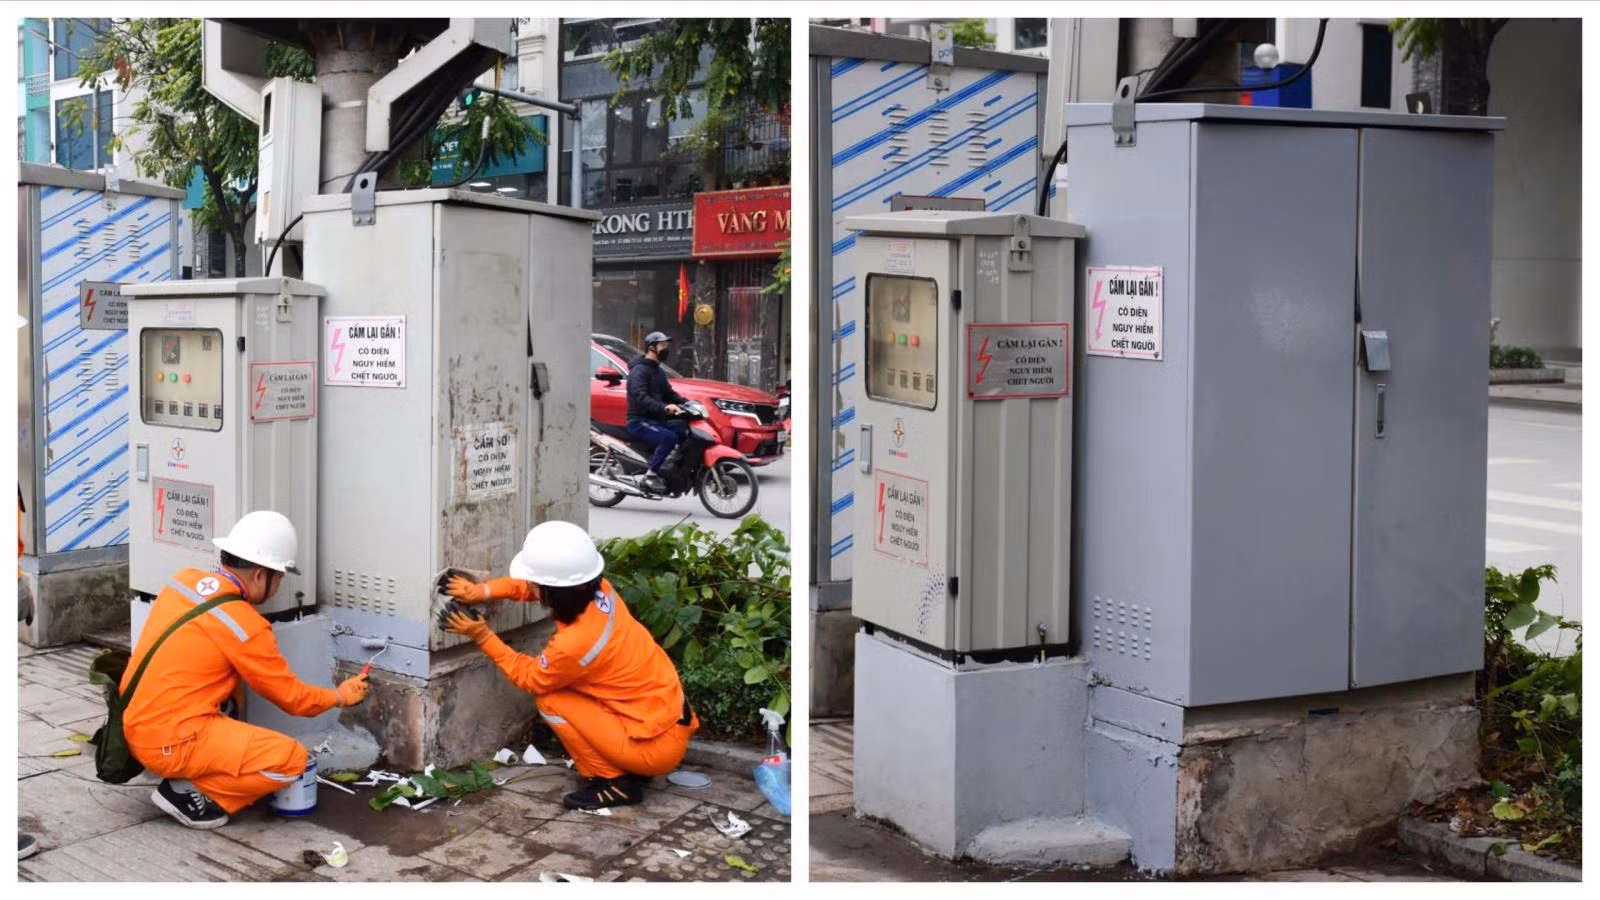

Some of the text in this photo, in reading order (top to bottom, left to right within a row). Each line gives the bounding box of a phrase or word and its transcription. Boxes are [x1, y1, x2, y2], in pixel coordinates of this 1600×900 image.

[592, 212, 650, 234] KONG
[717, 206, 768, 234] VÀNG
[1110, 274, 1124, 296] CẤM
[1126, 280, 1138, 299] LẠI
[1118, 304, 1148, 320] CÓ ĐIỆN
[349, 322, 365, 339] CẤM
[366, 326, 378, 342] LẠI
[1112, 319, 1154, 334] NGUY HIỂM
[1111, 336, 1130, 349] CHẾT
